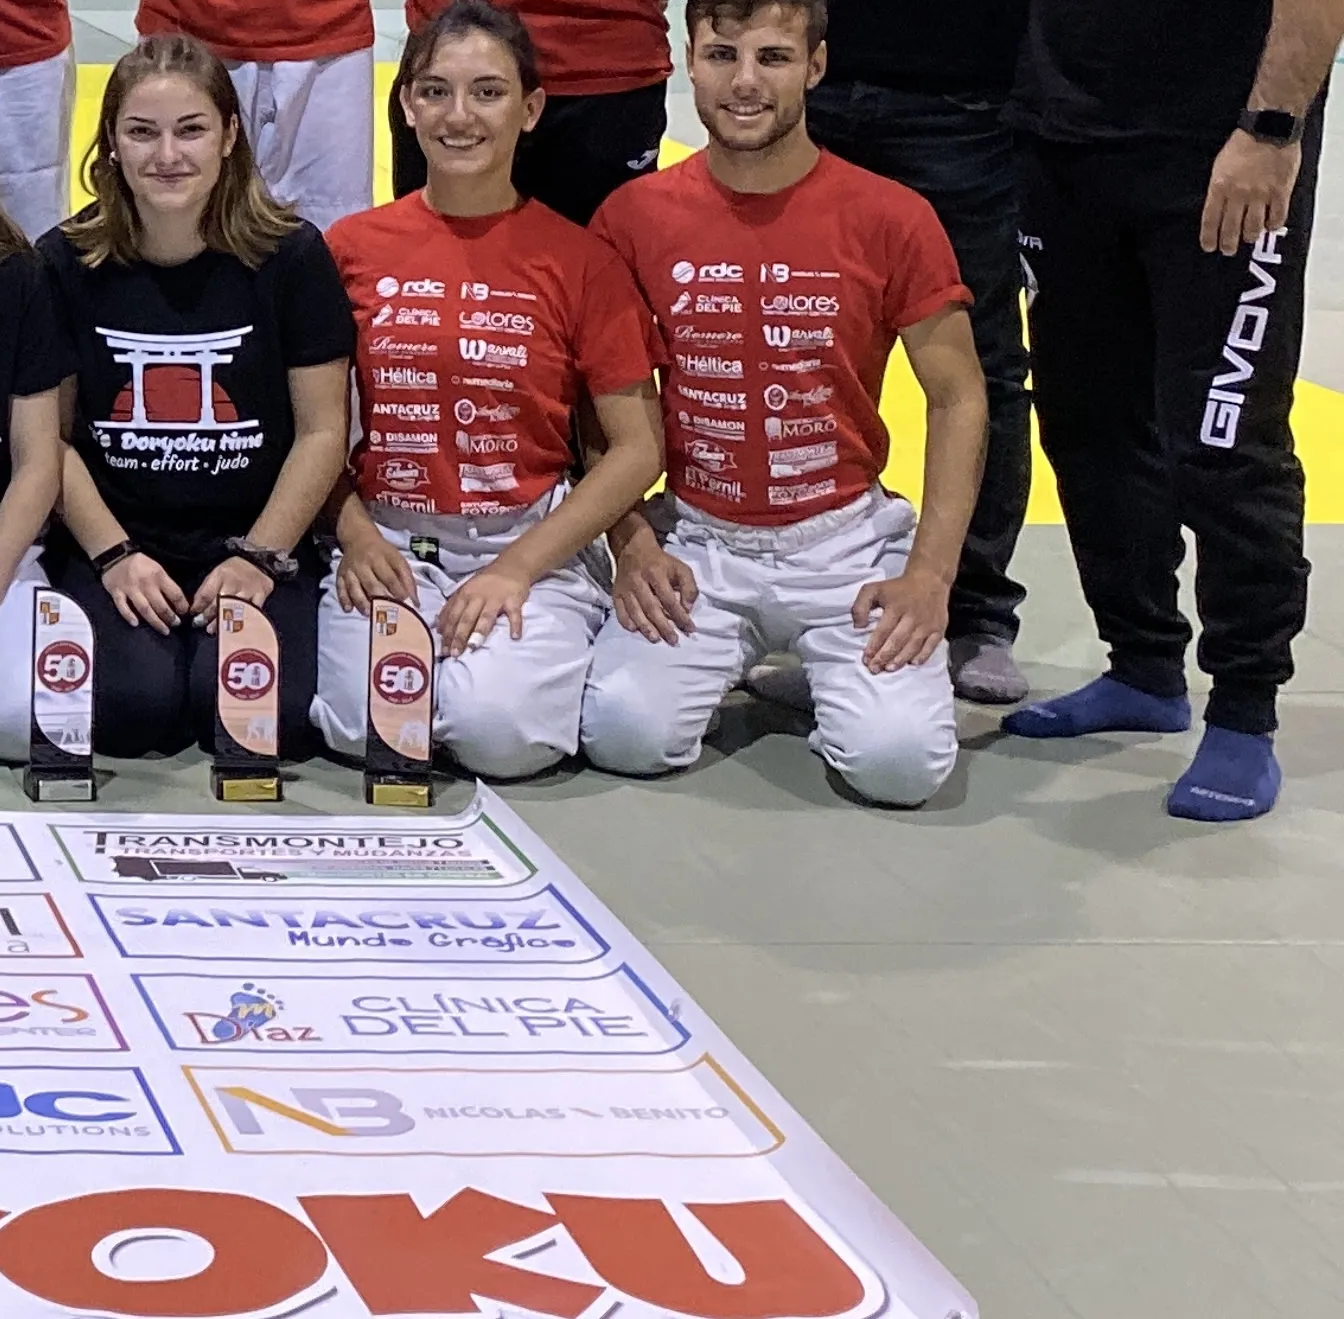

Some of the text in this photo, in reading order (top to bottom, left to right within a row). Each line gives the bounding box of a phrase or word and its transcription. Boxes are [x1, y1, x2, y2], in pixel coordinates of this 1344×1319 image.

[699, 263, 744, 278] rdc
[402, 279, 445, 293] rdc
[1200, 226, 1288, 449] GIVOVA
[687, 355, 742, 373] Héltica
[381, 367, 437, 384] Héltica
[121, 431, 264, 453] Doryoku time
[105, 452, 250, 475] team effort judo
[44, 654, 85, 682] 50
[381, 666, 423, 694] 50
[95, 832, 464, 854] TRANSMONTEJO
[121, 848, 302, 856] TRANSPORTES
[333, 849, 473, 857] MUDANZAS
[113, 907, 564, 930] SANTACRUZ
[287, 930, 413, 948] Mundo
[351, 993, 607, 1014] CLÍNICA
[340, 1014, 651, 1037] DEL PIE
[215, 1087, 416, 1137] NB
[422, 1106, 730, 1121] NICOLAS BENITO
